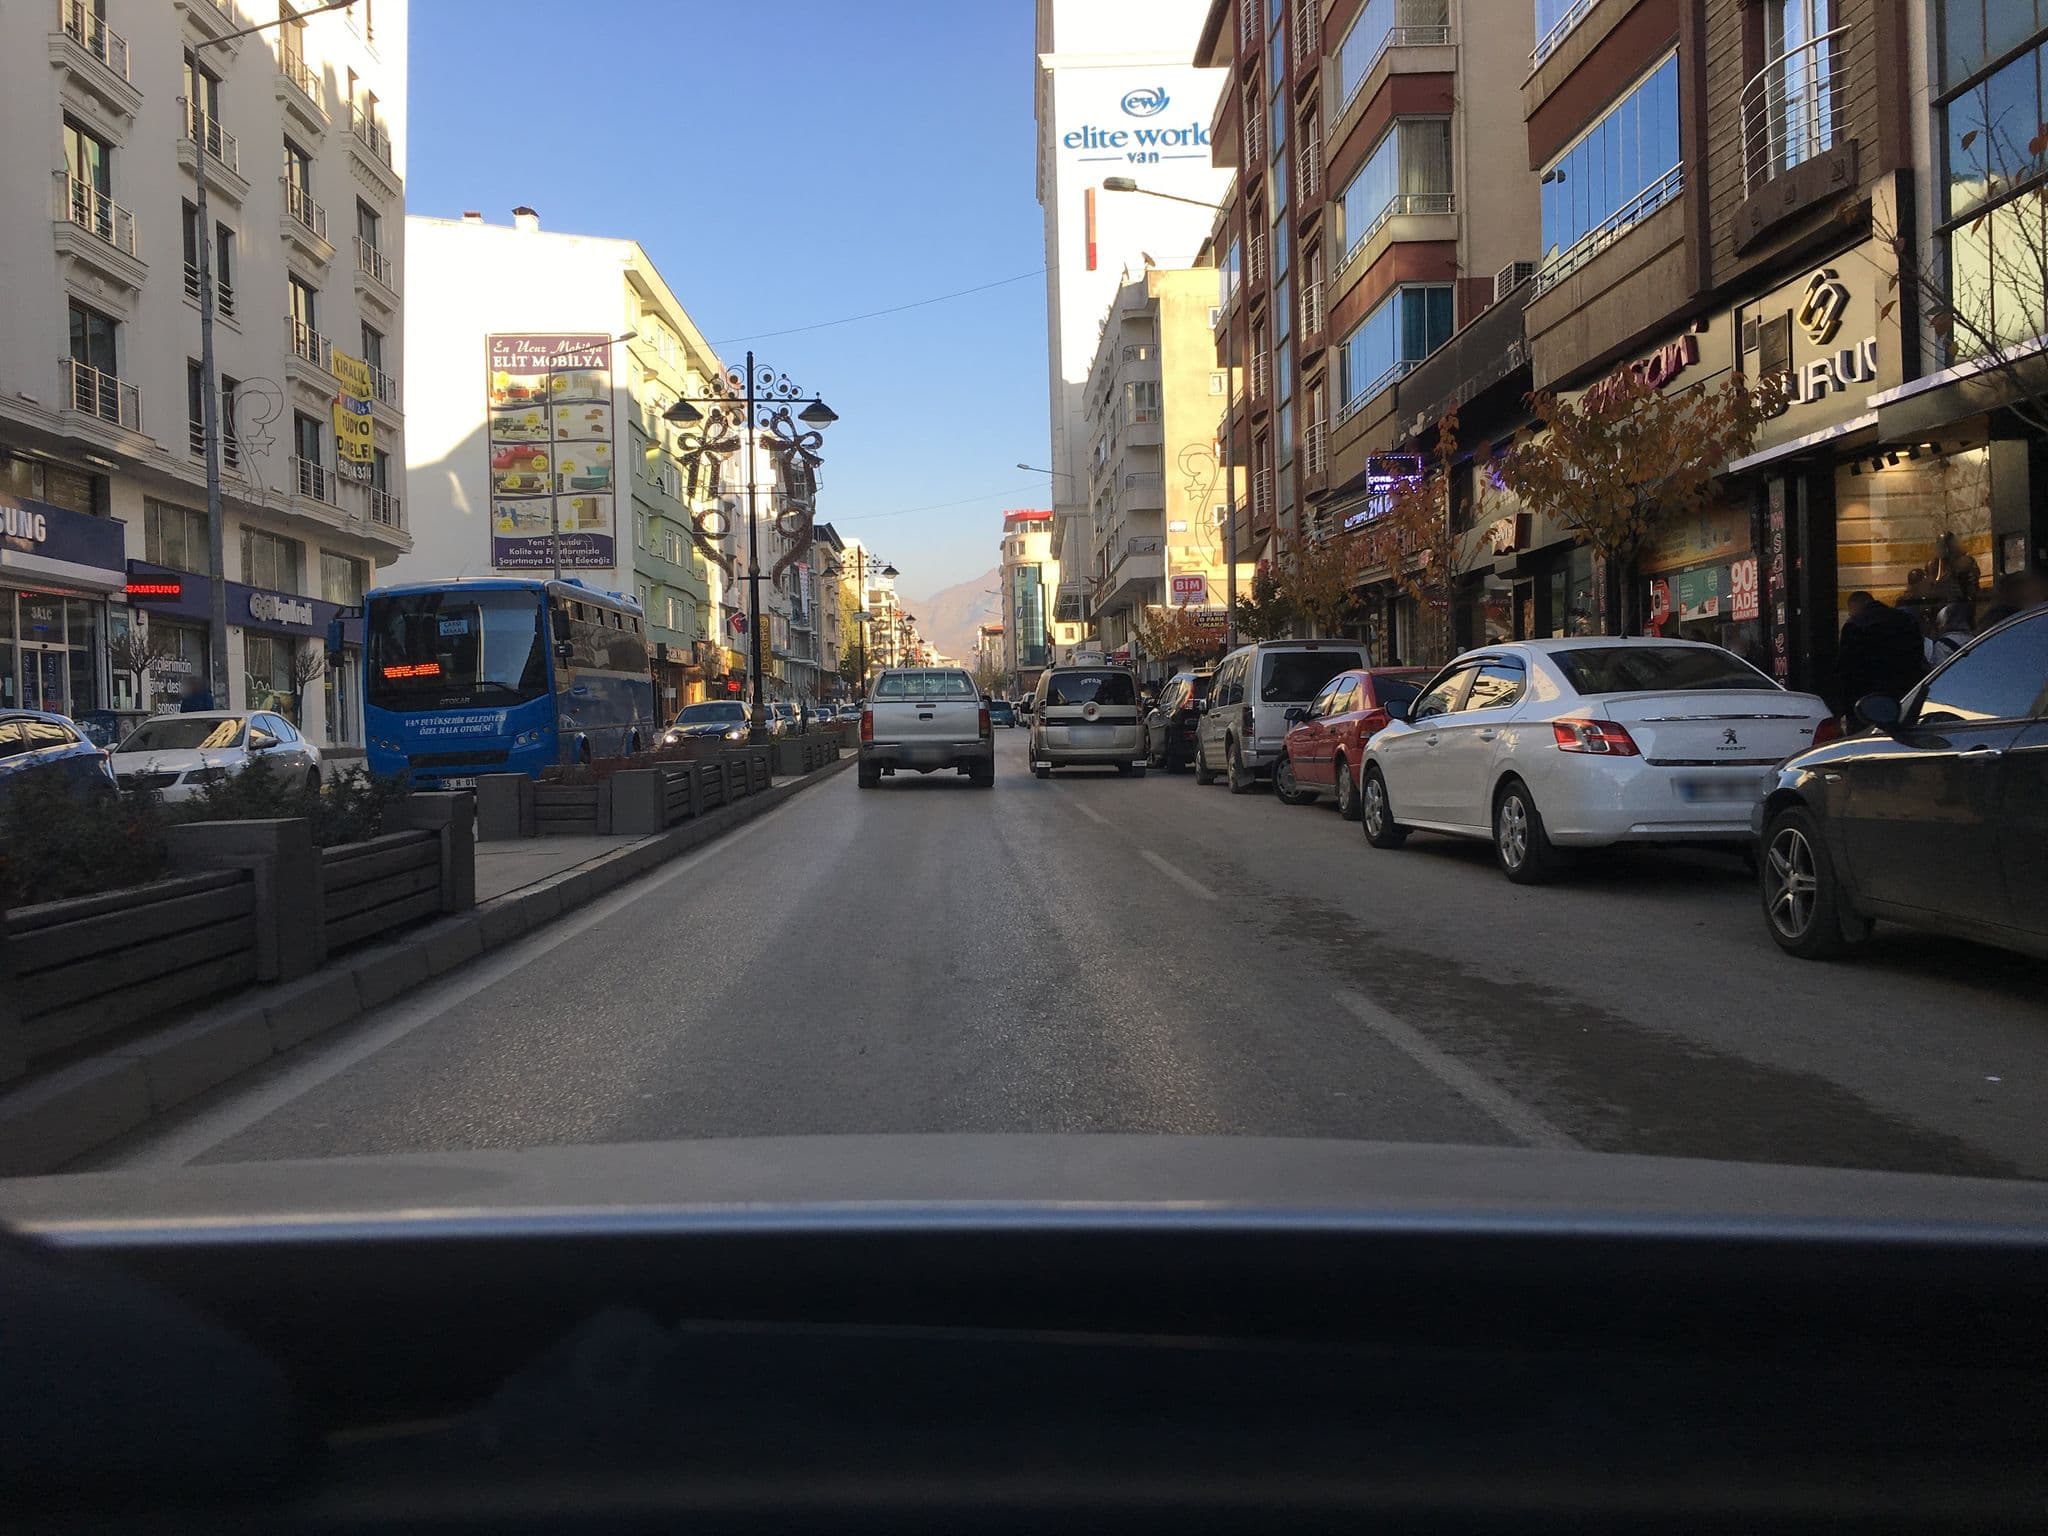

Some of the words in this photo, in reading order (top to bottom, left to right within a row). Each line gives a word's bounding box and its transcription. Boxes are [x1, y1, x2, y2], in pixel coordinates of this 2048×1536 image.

[1063, 125, 1129, 149] elite
[1126, 151, 1160, 164] van
[493, 341, 510, 353] En
[515, 341, 547, 353] Ucuz
[493, 354, 528, 368] ELİT
[532, 354, 605, 368] MOBİLYA
[546, 548, 600, 556] Fiatlarımızla
[575, 557, 611, 565] Edeceğiz
[1731, 560, 1753, 593] 90
[126, 584, 181, 594] SAMSUNG
[405, 719, 420, 727] VAN
[420, 727, 437, 735] ÖZEL
[439, 726, 458, 734] HALK
